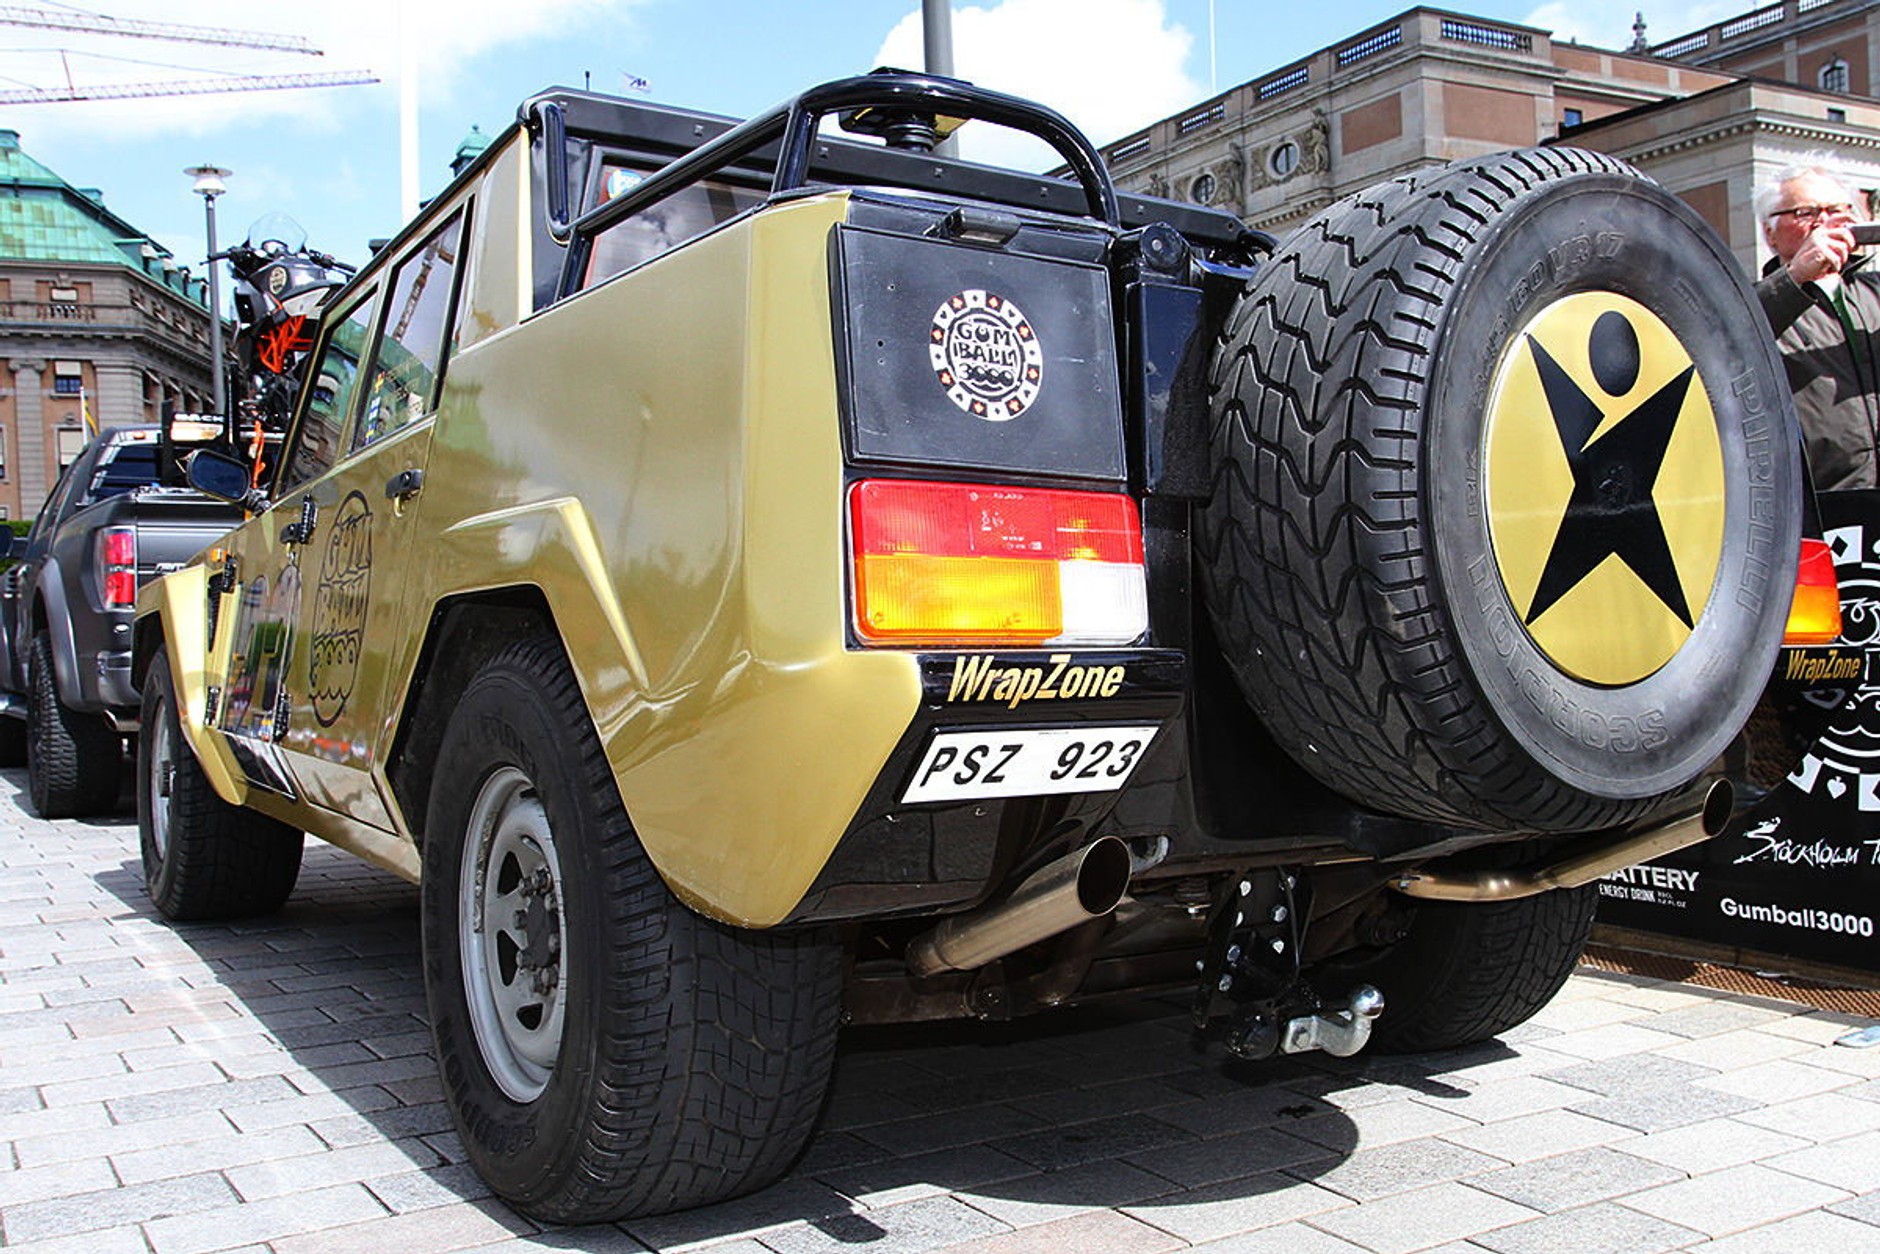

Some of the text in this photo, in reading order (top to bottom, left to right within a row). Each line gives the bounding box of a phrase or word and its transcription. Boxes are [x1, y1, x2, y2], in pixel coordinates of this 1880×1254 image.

[1731, 367, 1775, 616] PIRELLI
[1467, 553, 1669, 754] SCORPION
[1786, 649, 1861, 687] WrapZone
[947, 653, 1126, 710] WrapZone
[919, 740, 1142, 788] PSZ 923
[1599, 864, 1700, 892] ATTERY
[1720, 897, 1874, 937] Gumball3000
